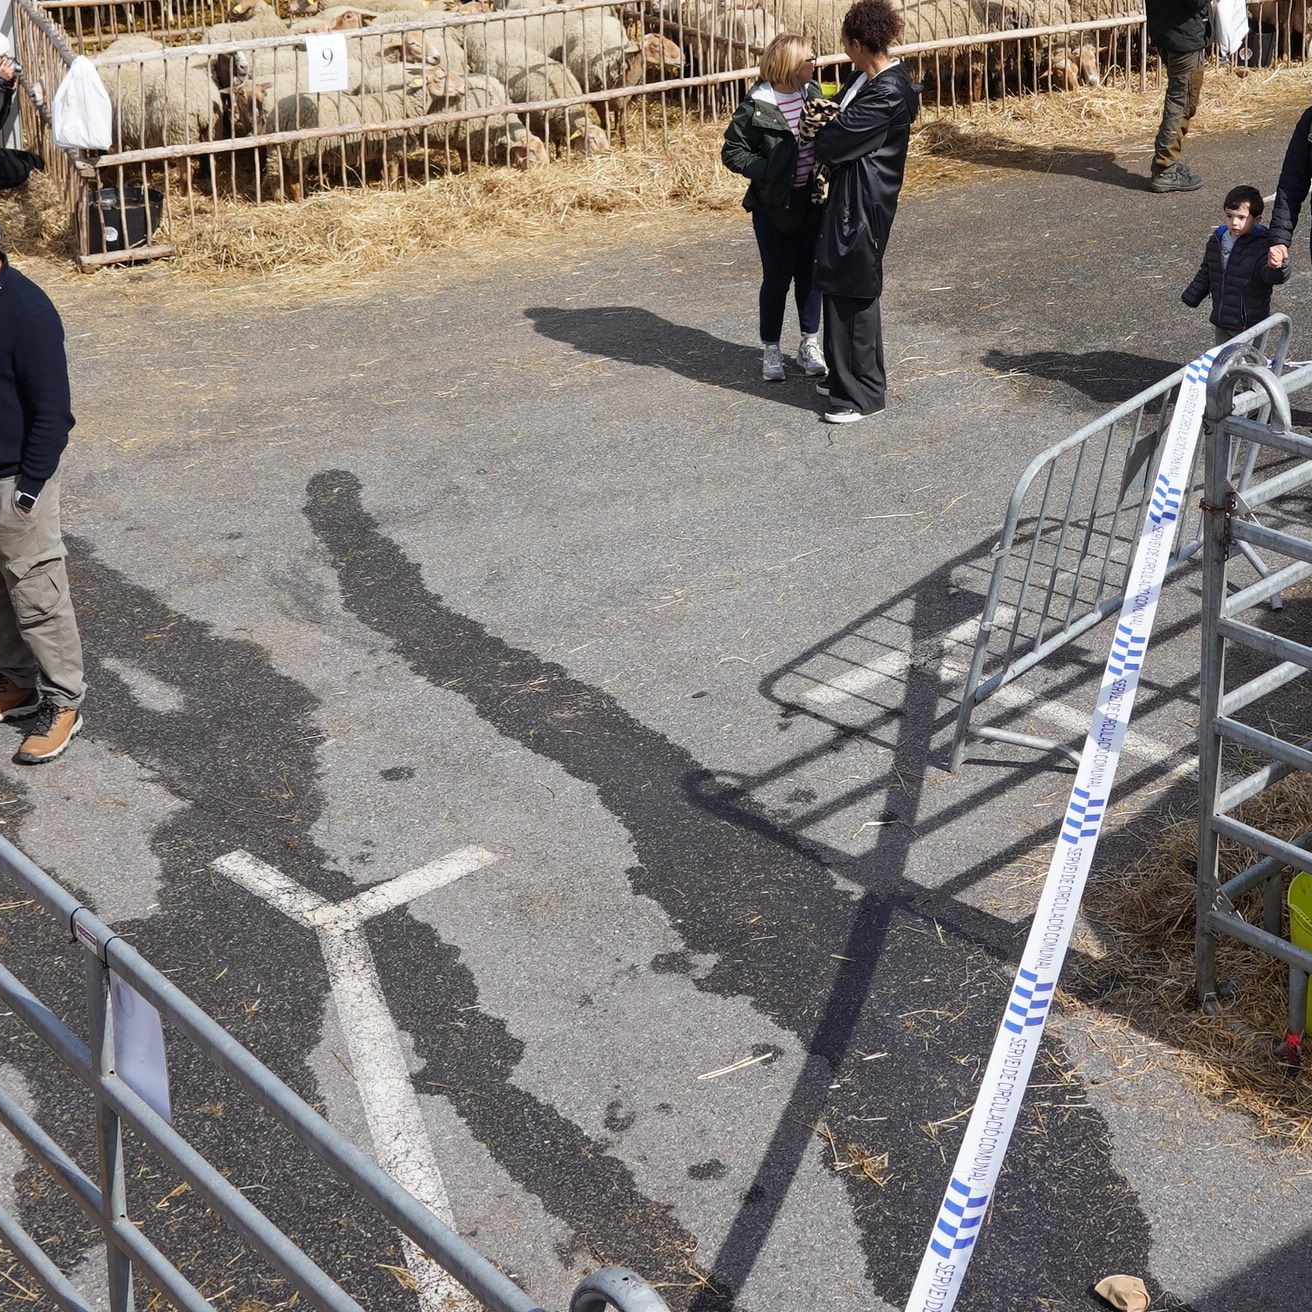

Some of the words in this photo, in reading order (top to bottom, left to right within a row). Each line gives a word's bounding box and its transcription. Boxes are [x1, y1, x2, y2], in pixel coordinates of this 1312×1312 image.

[321, 47, 334, 68] 9
[1109, 678, 1127, 702] SERVEI
[1106, 701, 1120, 712] DE
[1063, 846, 1082, 873] SERVEI
[1059, 873, 1075, 884] DE
[1047, 885, 1072, 931] CIRCULACIÓ
[1034, 932, 1059, 970] COMUNAL
[1004, 1036, 1027, 1068] SERVEI
[999, 1067, 1018, 1081] DE
[983, 1081, 1013, 1136] CIRCULACIÓ
[968, 1137, 996, 1184] COMUNAL
[927, 1261, 955, 1301] SERVEI
